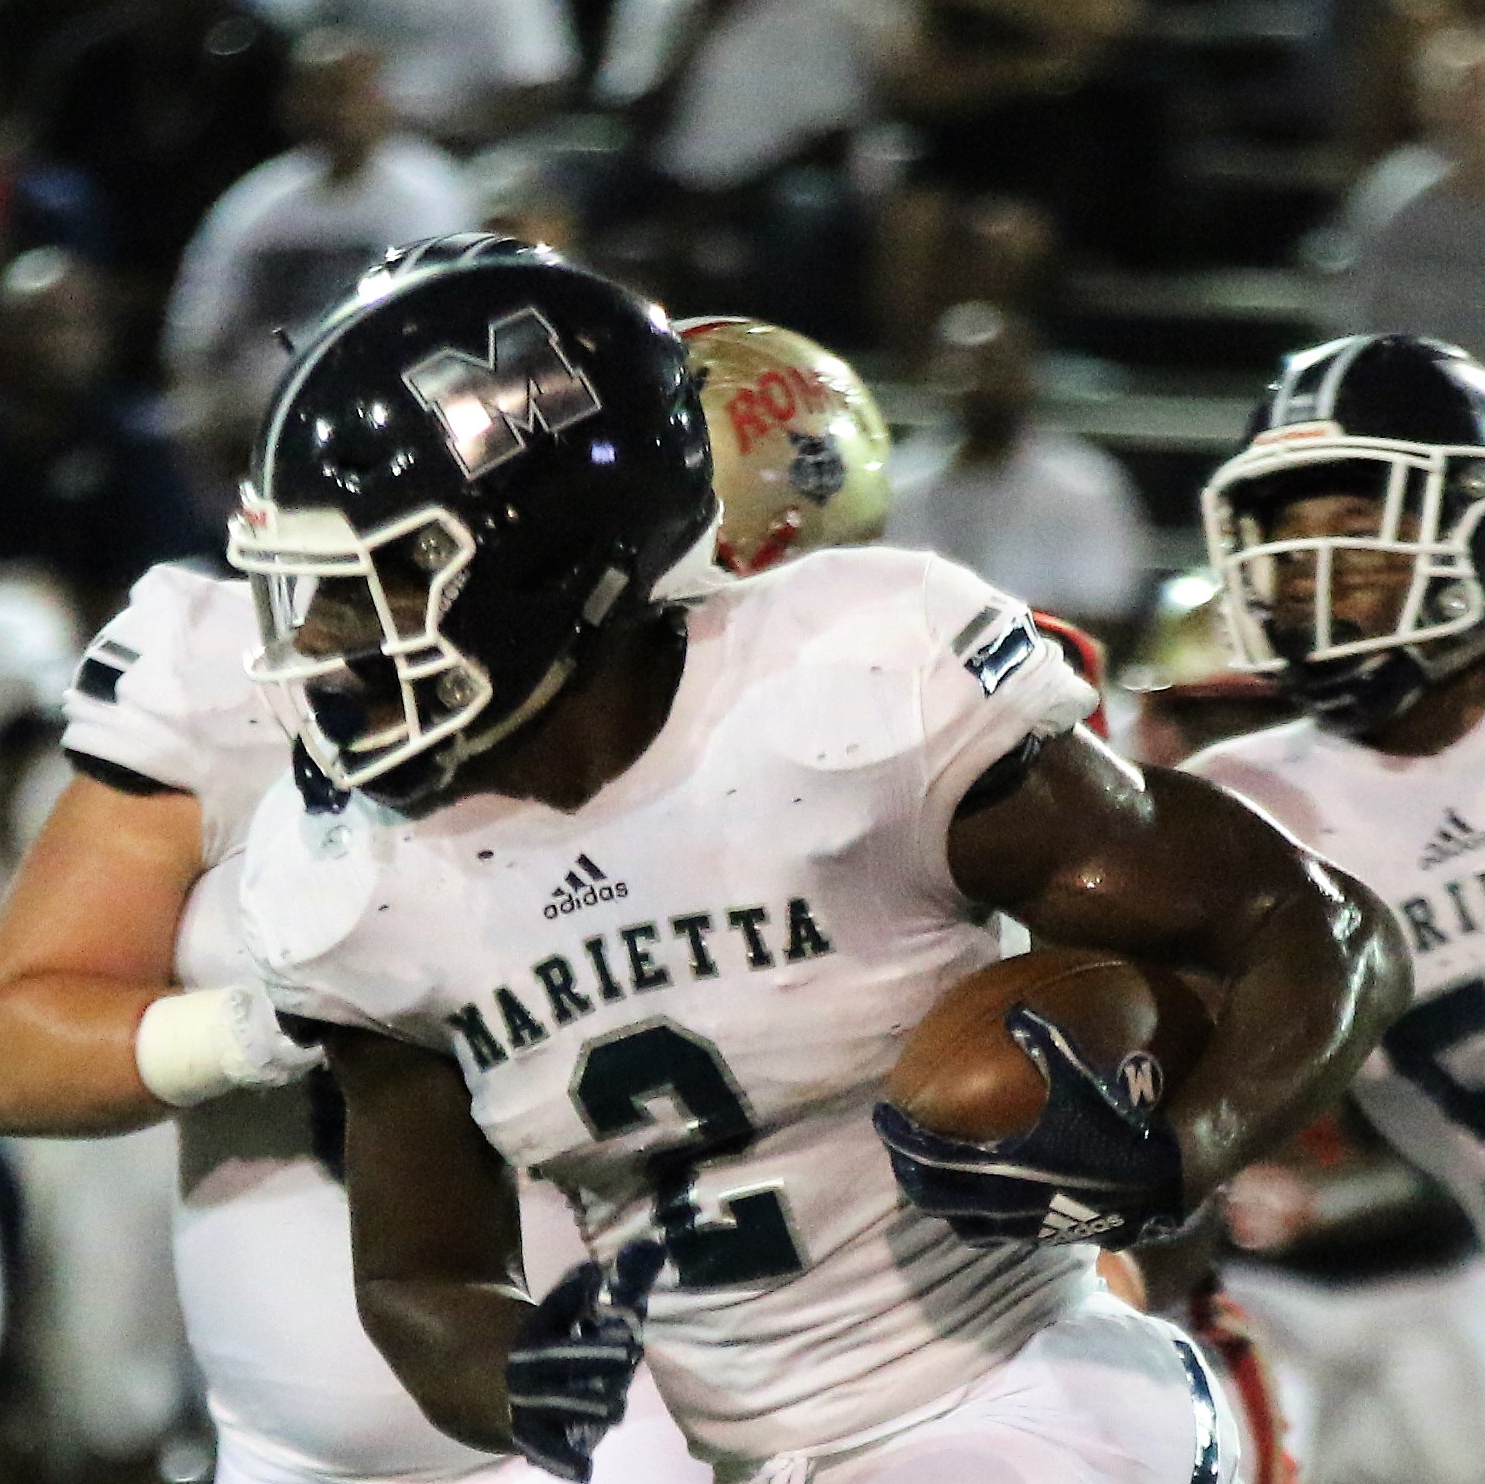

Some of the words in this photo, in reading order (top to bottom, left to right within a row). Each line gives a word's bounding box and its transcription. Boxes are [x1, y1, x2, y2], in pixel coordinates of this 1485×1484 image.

[400, 306, 603, 483] M
[543, 880, 629, 921] adidas
[566, 1012, 808, 1293] 2
